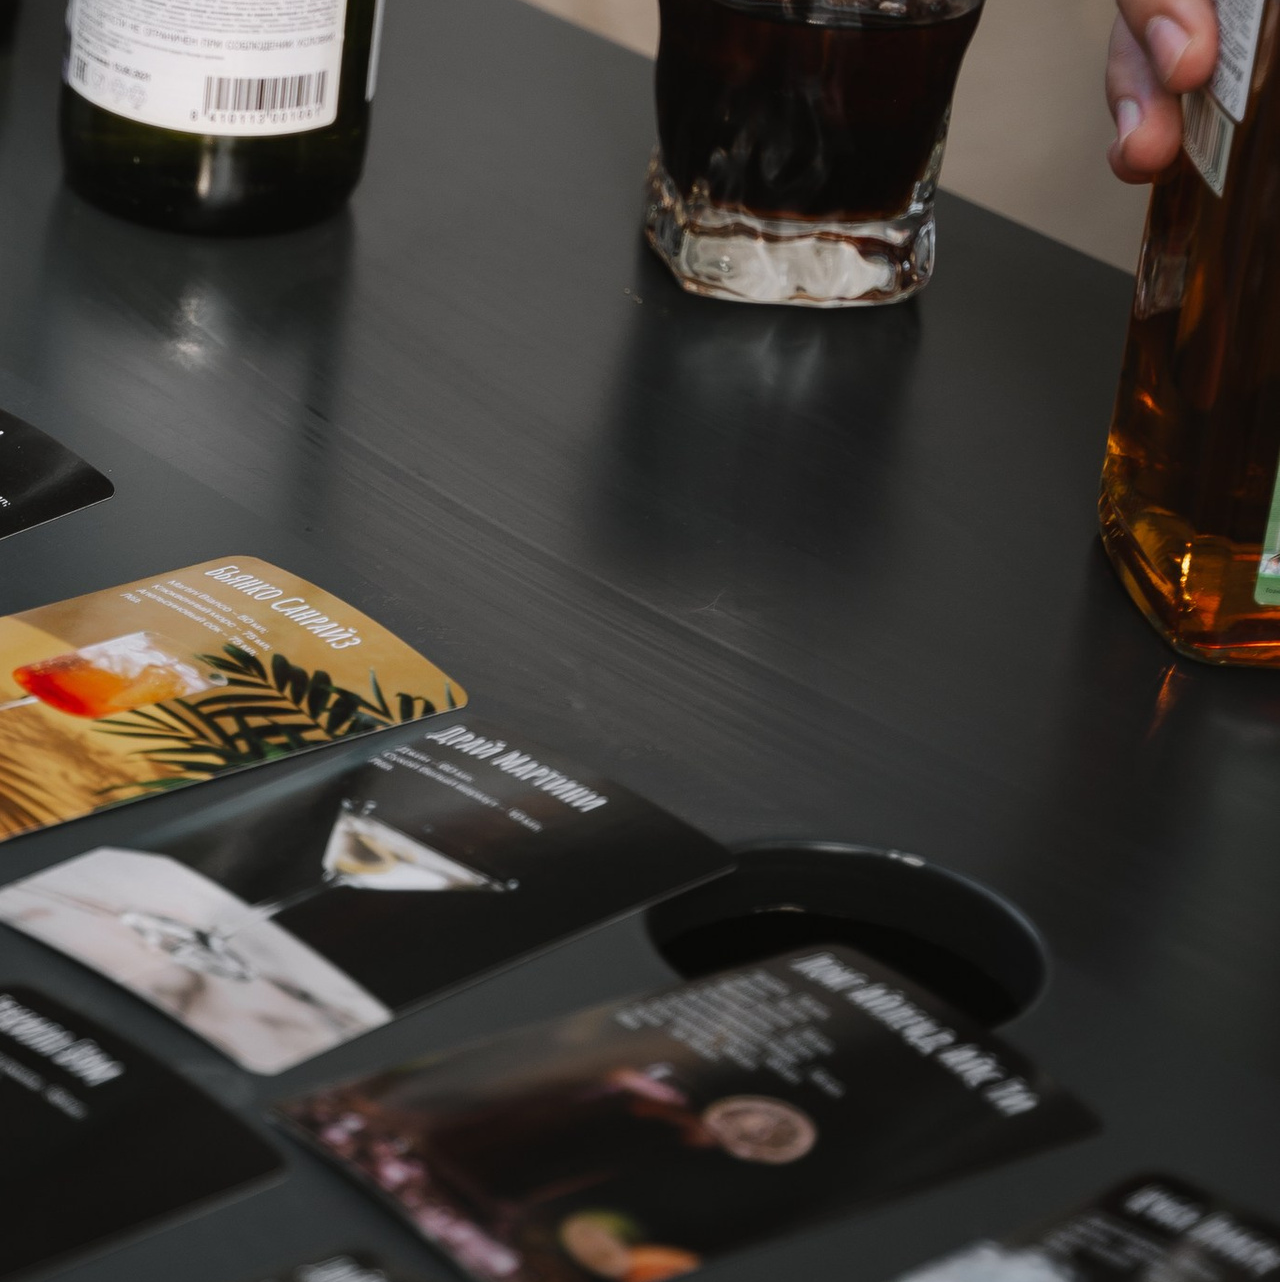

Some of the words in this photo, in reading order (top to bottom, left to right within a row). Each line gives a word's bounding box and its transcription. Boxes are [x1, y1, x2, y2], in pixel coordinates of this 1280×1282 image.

[203, 620, 224, 634] сок
[228, 635, 244, 646] 75
[204, 565, 284, 601] БЬЯНКО
[270, 597, 362, 650] САНРАЙЗ
[209, 610, 237, 629] морс
[243, 630, 257, 639] 75
[425, 724, 507, 760] ДРАЙ
[489, 749, 608, 813] МАРТИНИ
